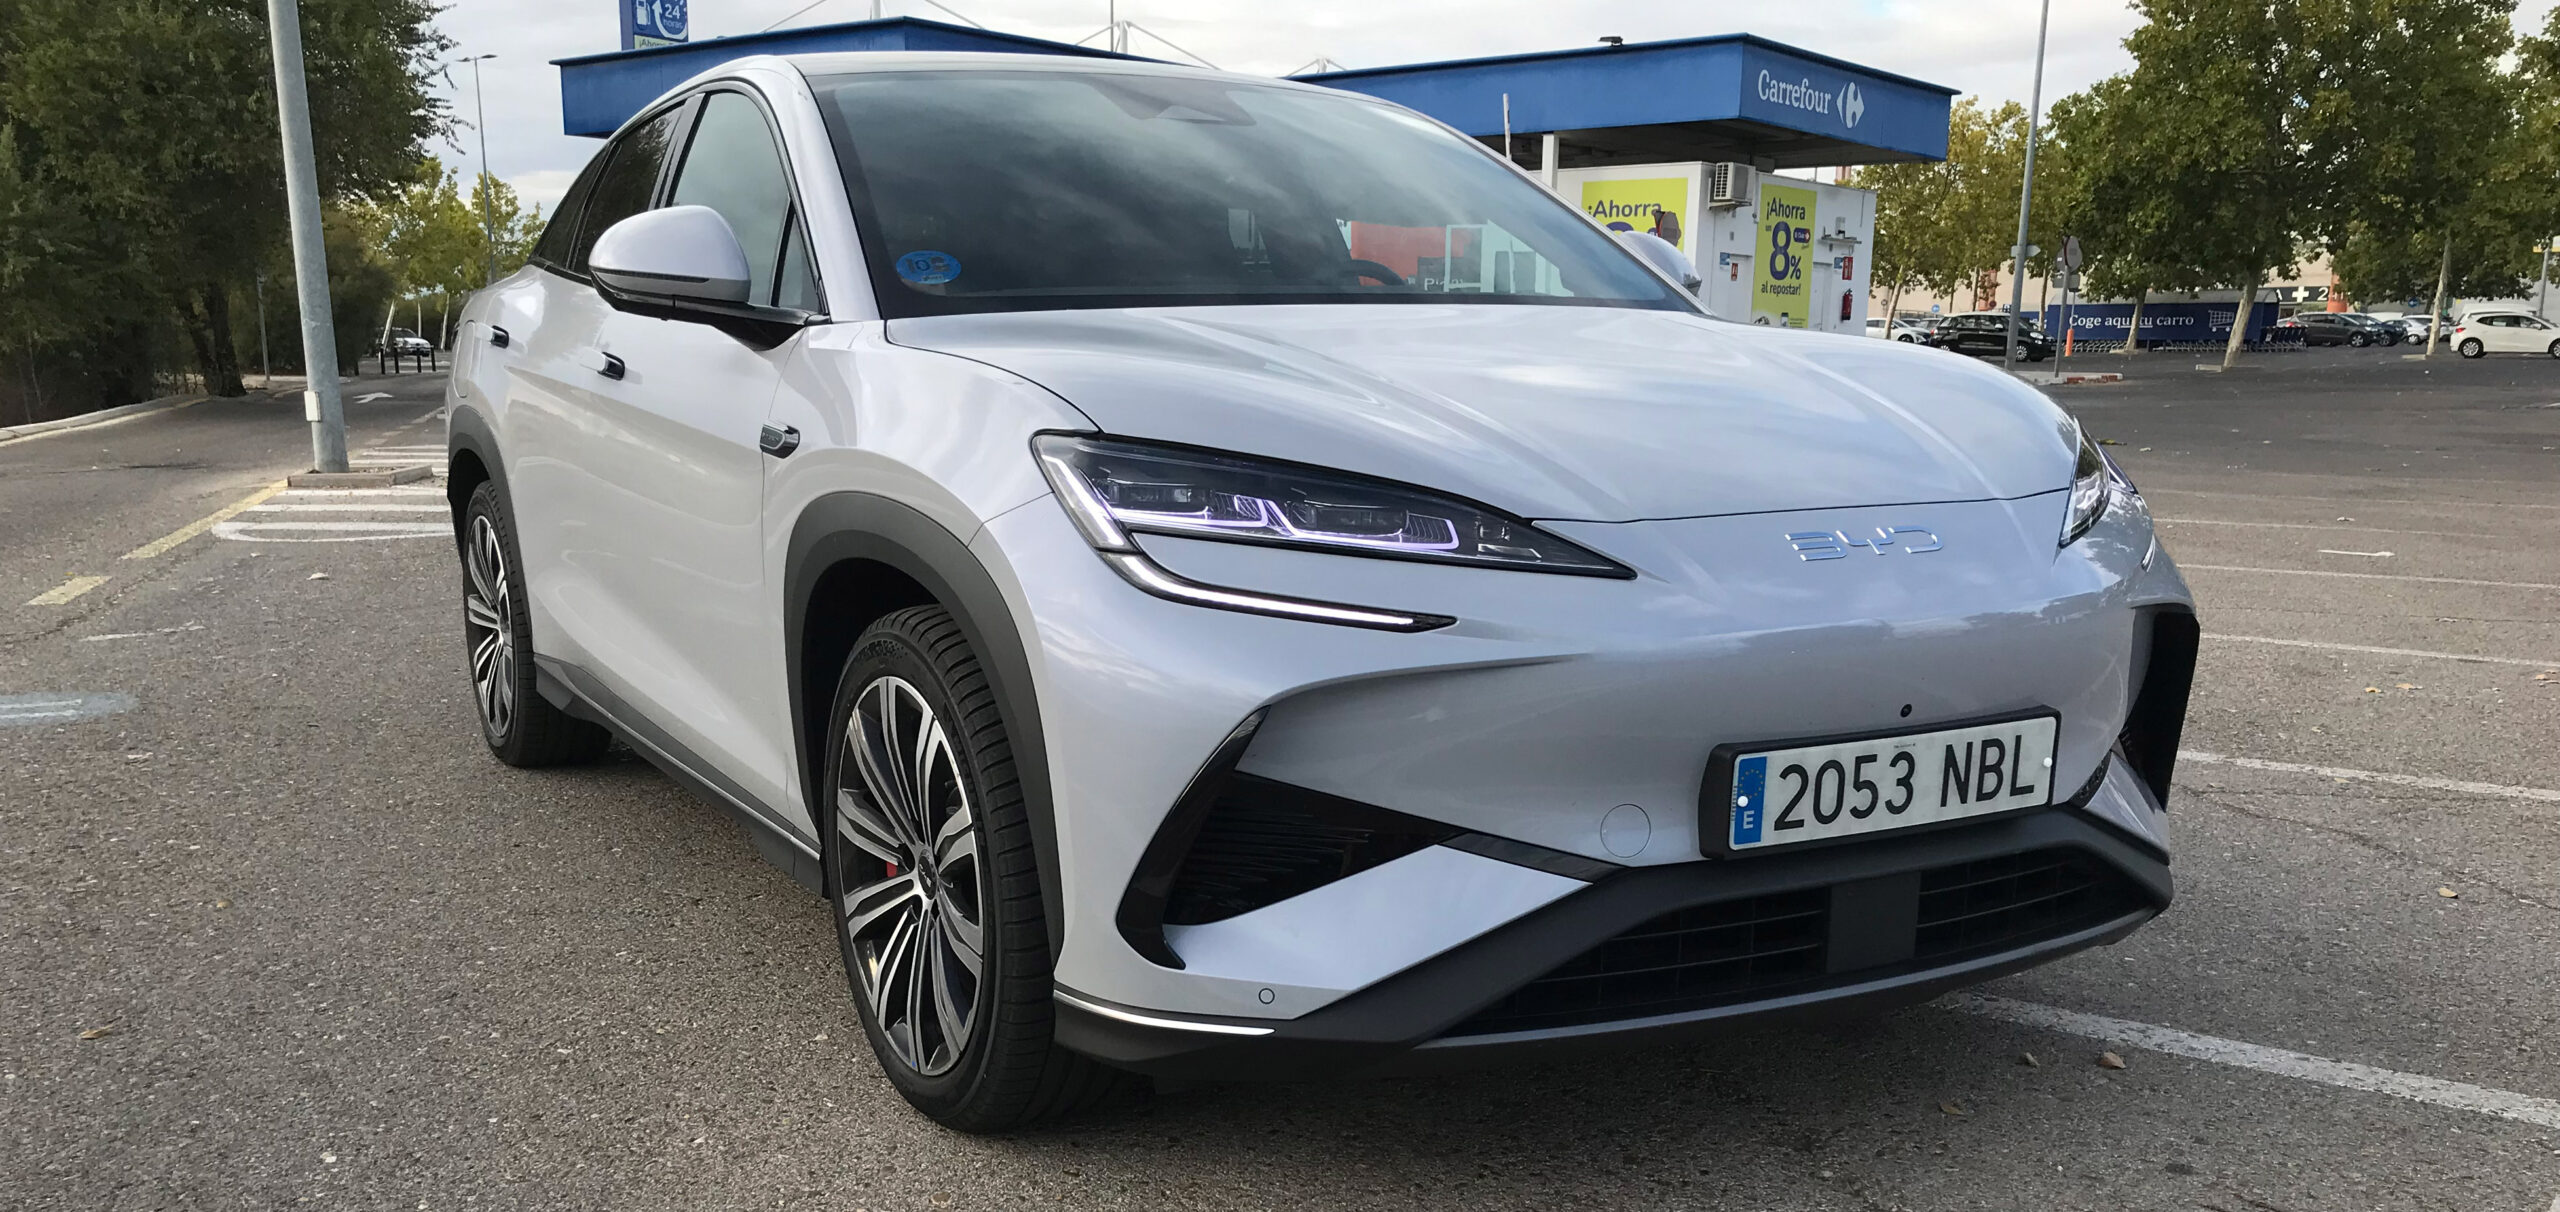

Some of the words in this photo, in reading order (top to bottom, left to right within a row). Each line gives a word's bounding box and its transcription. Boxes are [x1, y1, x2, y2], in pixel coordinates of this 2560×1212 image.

[665, 3, 680, 19] 24
[1757, 69, 1832, 115] Carrefour
[1766, 196, 1806, 221] ¡Ahorra
[1761, 280, 1768, 294] al
[1769, 283, 1802, 297] repostar!
[2069, 314, 2102, 329] Coge
[2104, 316, 2132, 329] aqu
[2139, 315, 2153, 328] tu
[2156, 316, 2194, 326] carro
[1785, 525, 1944, 562] BYD
[1773, 751, 1916, 832] 2053
[1939, 735, 2036, 808] NBL
[1743, 810, 1755, 830] E
